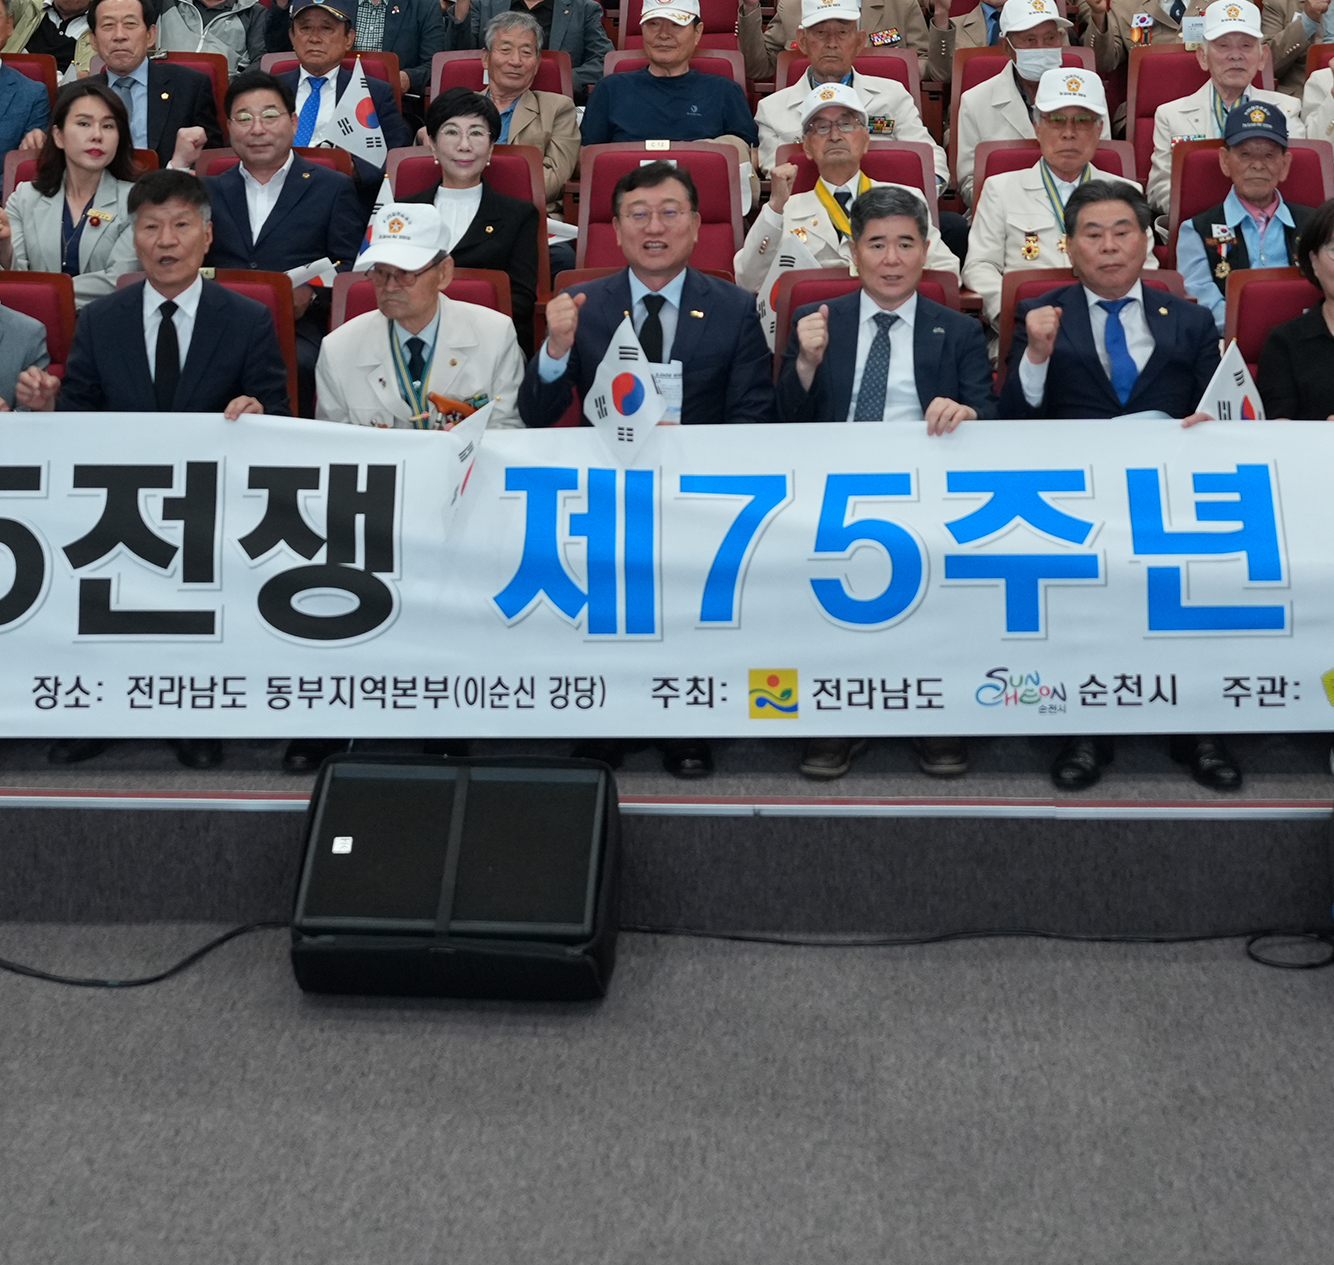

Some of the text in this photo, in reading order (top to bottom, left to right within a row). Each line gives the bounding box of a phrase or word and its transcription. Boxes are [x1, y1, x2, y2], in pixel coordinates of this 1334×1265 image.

[493, 463, 1286, 635] 제75주년
[32, 675, 103, 710] 장소:
[127, 675, 247, 709] 전라남도
[266, 675, 535, 710] 동부지역본부(이순신
[549, 676, 606, 710] 강당)
[651, 676, 727, 709] 주최:
[812, 678, 945, 711] 전라남도
[1079, 673, 1177, 707] 순천시
[1223, 675, 1300, 708] 주관:
[1038, 704, 1067, 715] 순천시
